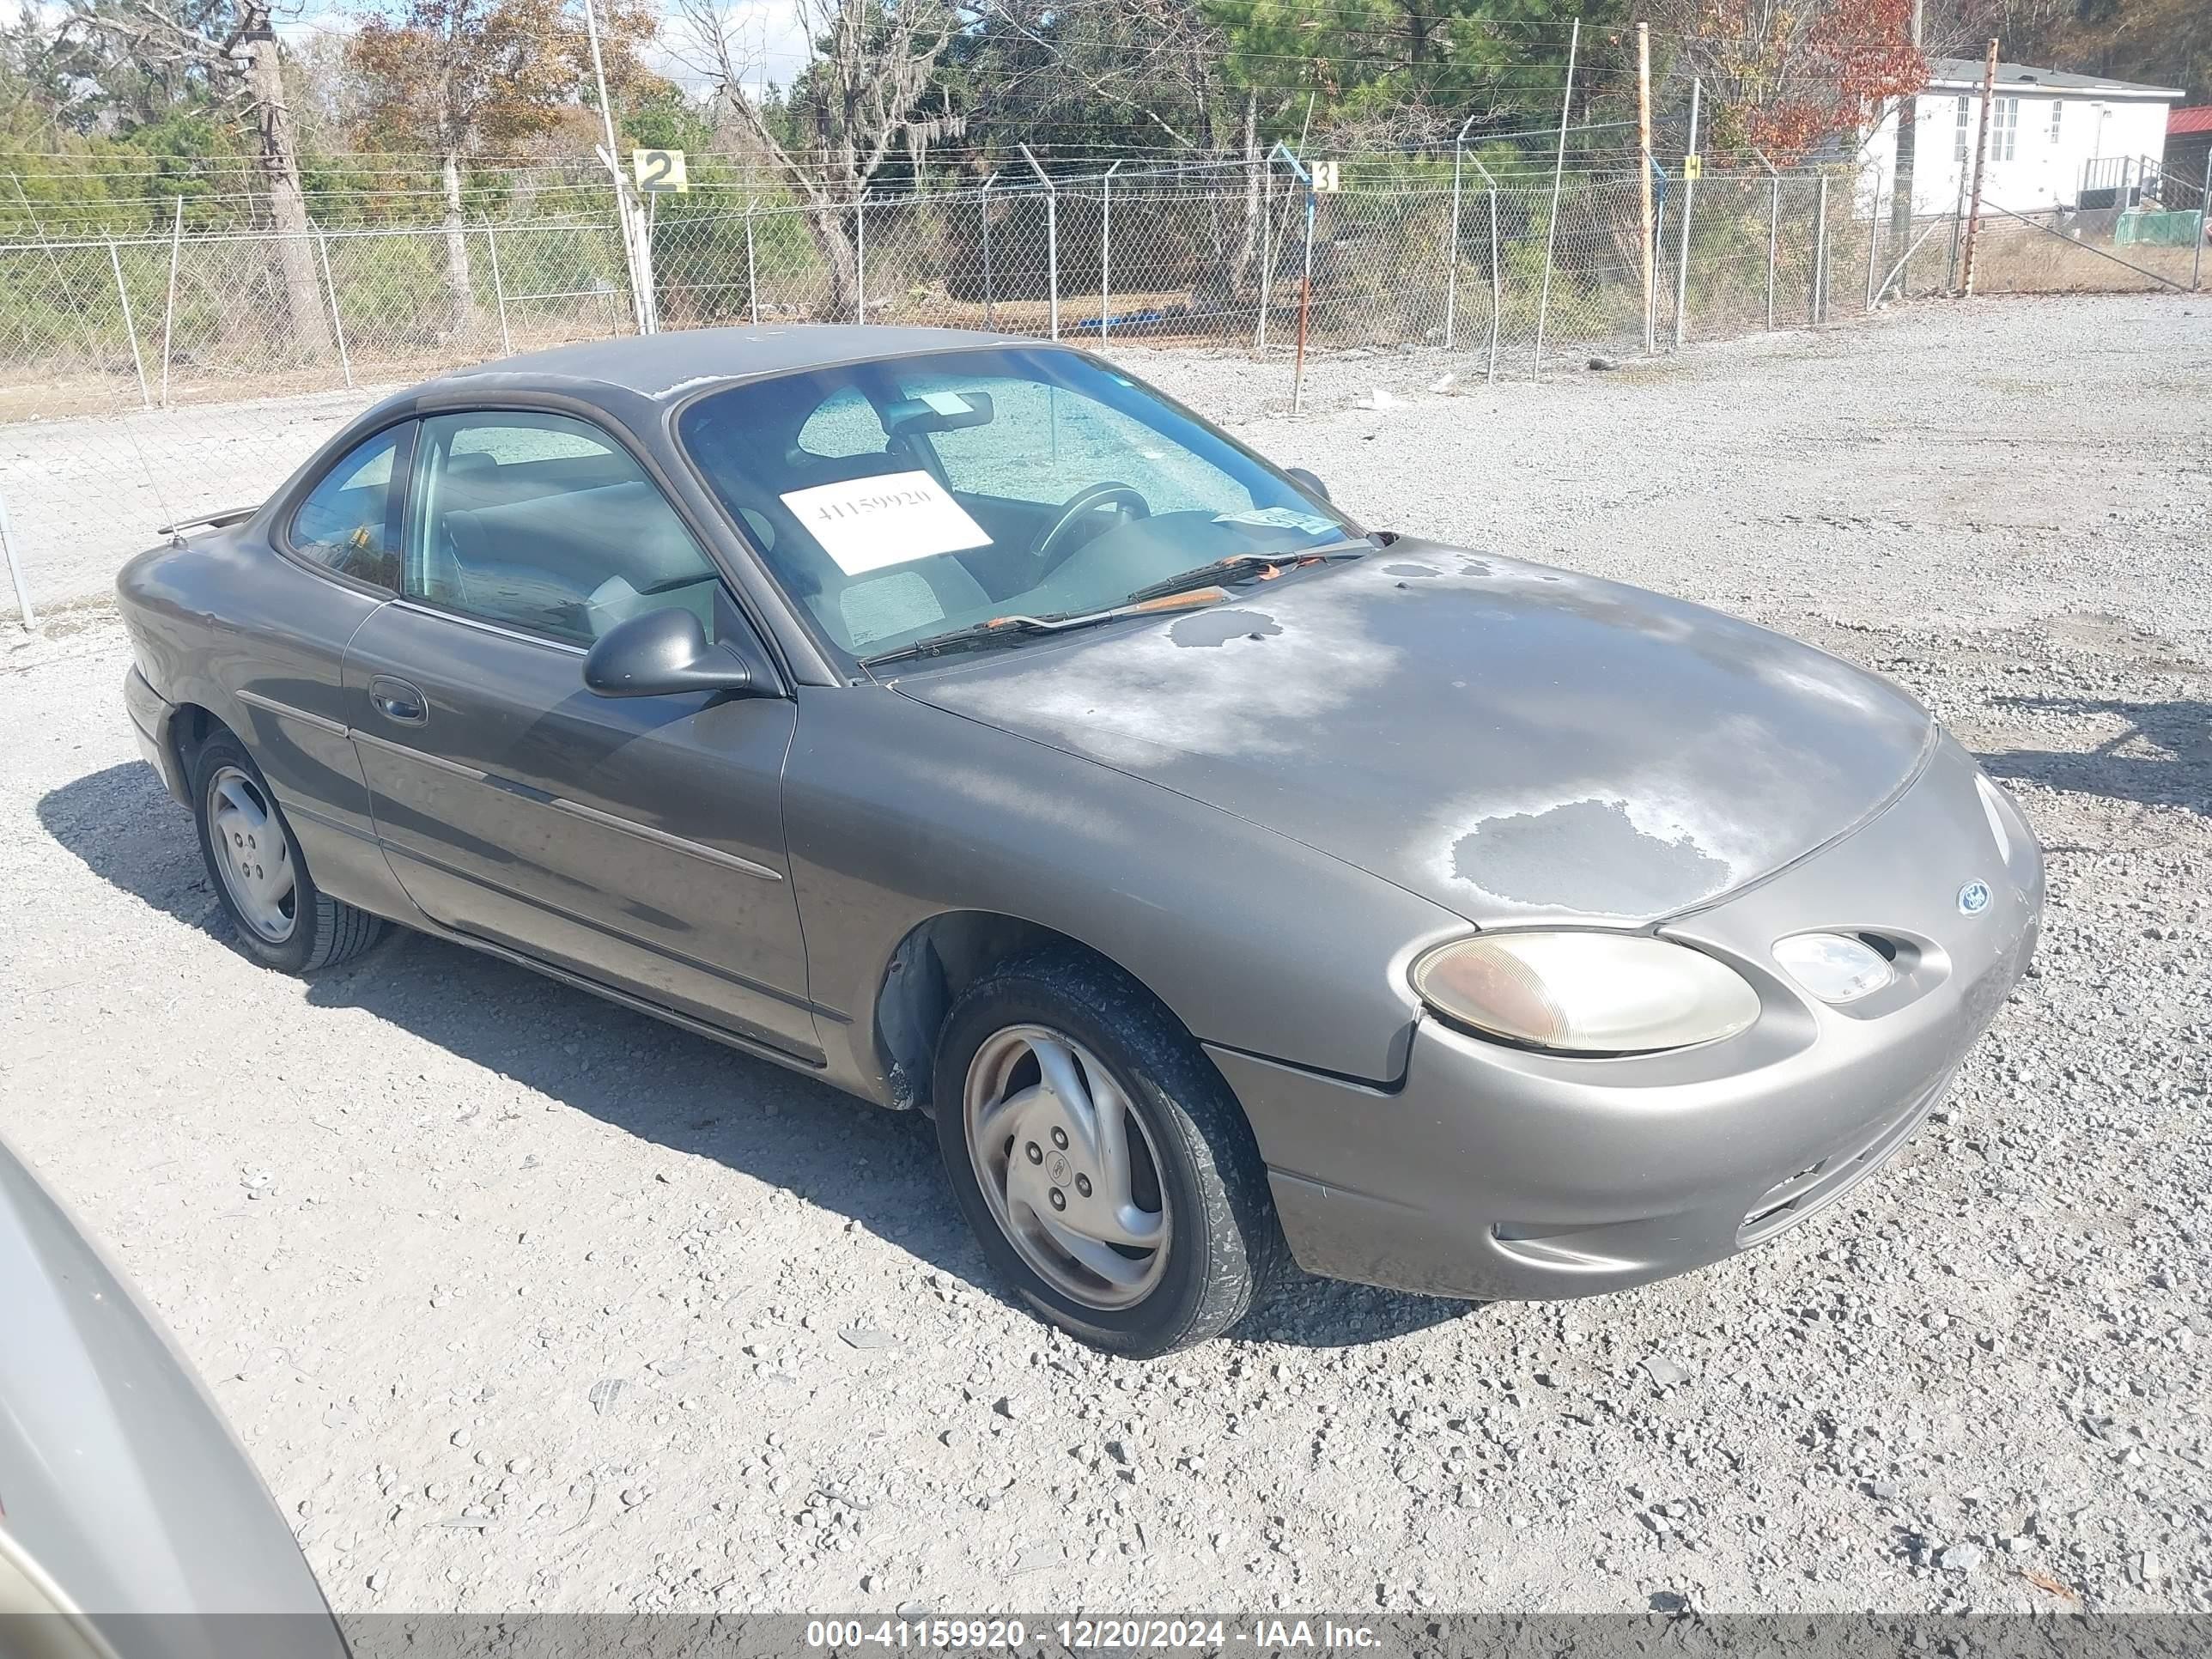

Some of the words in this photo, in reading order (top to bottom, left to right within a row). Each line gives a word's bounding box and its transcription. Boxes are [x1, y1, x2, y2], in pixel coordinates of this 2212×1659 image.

[641, 151, 677, 191] 2
[1317, 162, 1329, 191] 3
[1690, 155, 1698, 179] 4
